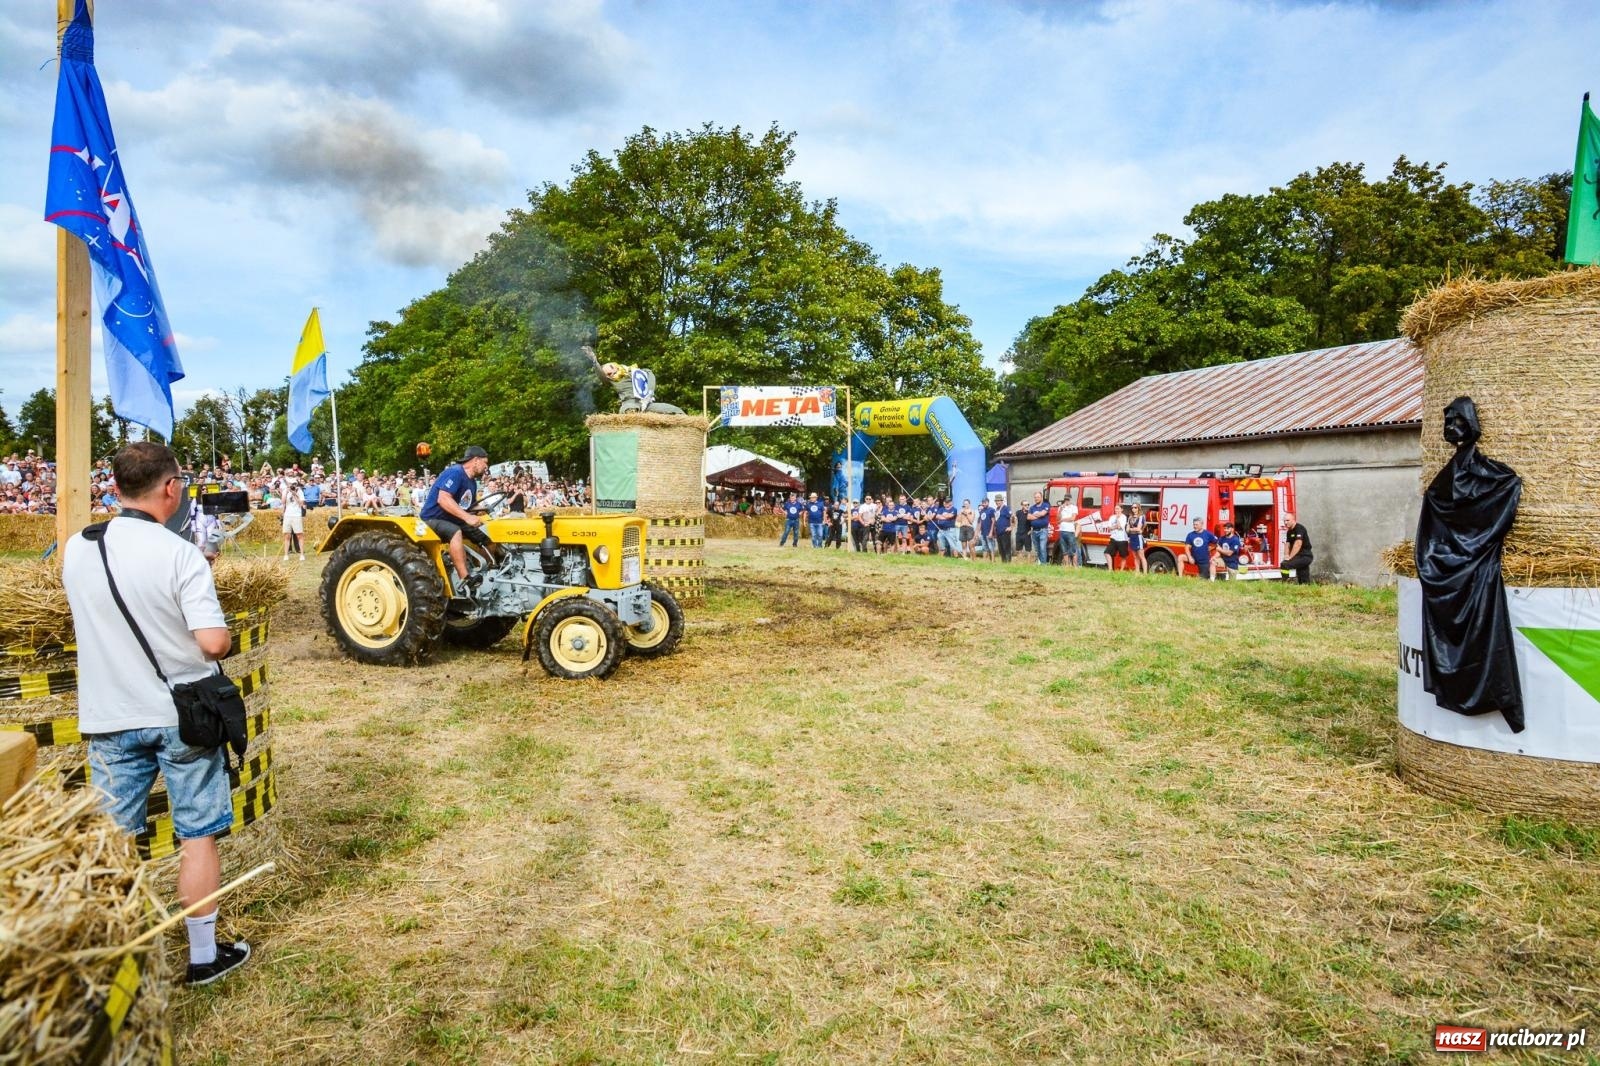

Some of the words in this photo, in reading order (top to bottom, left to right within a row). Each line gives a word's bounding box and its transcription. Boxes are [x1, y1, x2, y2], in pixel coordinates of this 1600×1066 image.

[741, 397, 820, 417] META
[928, 412, 942, 433] Gmina
[1170, 504, 1188, 526] 24
